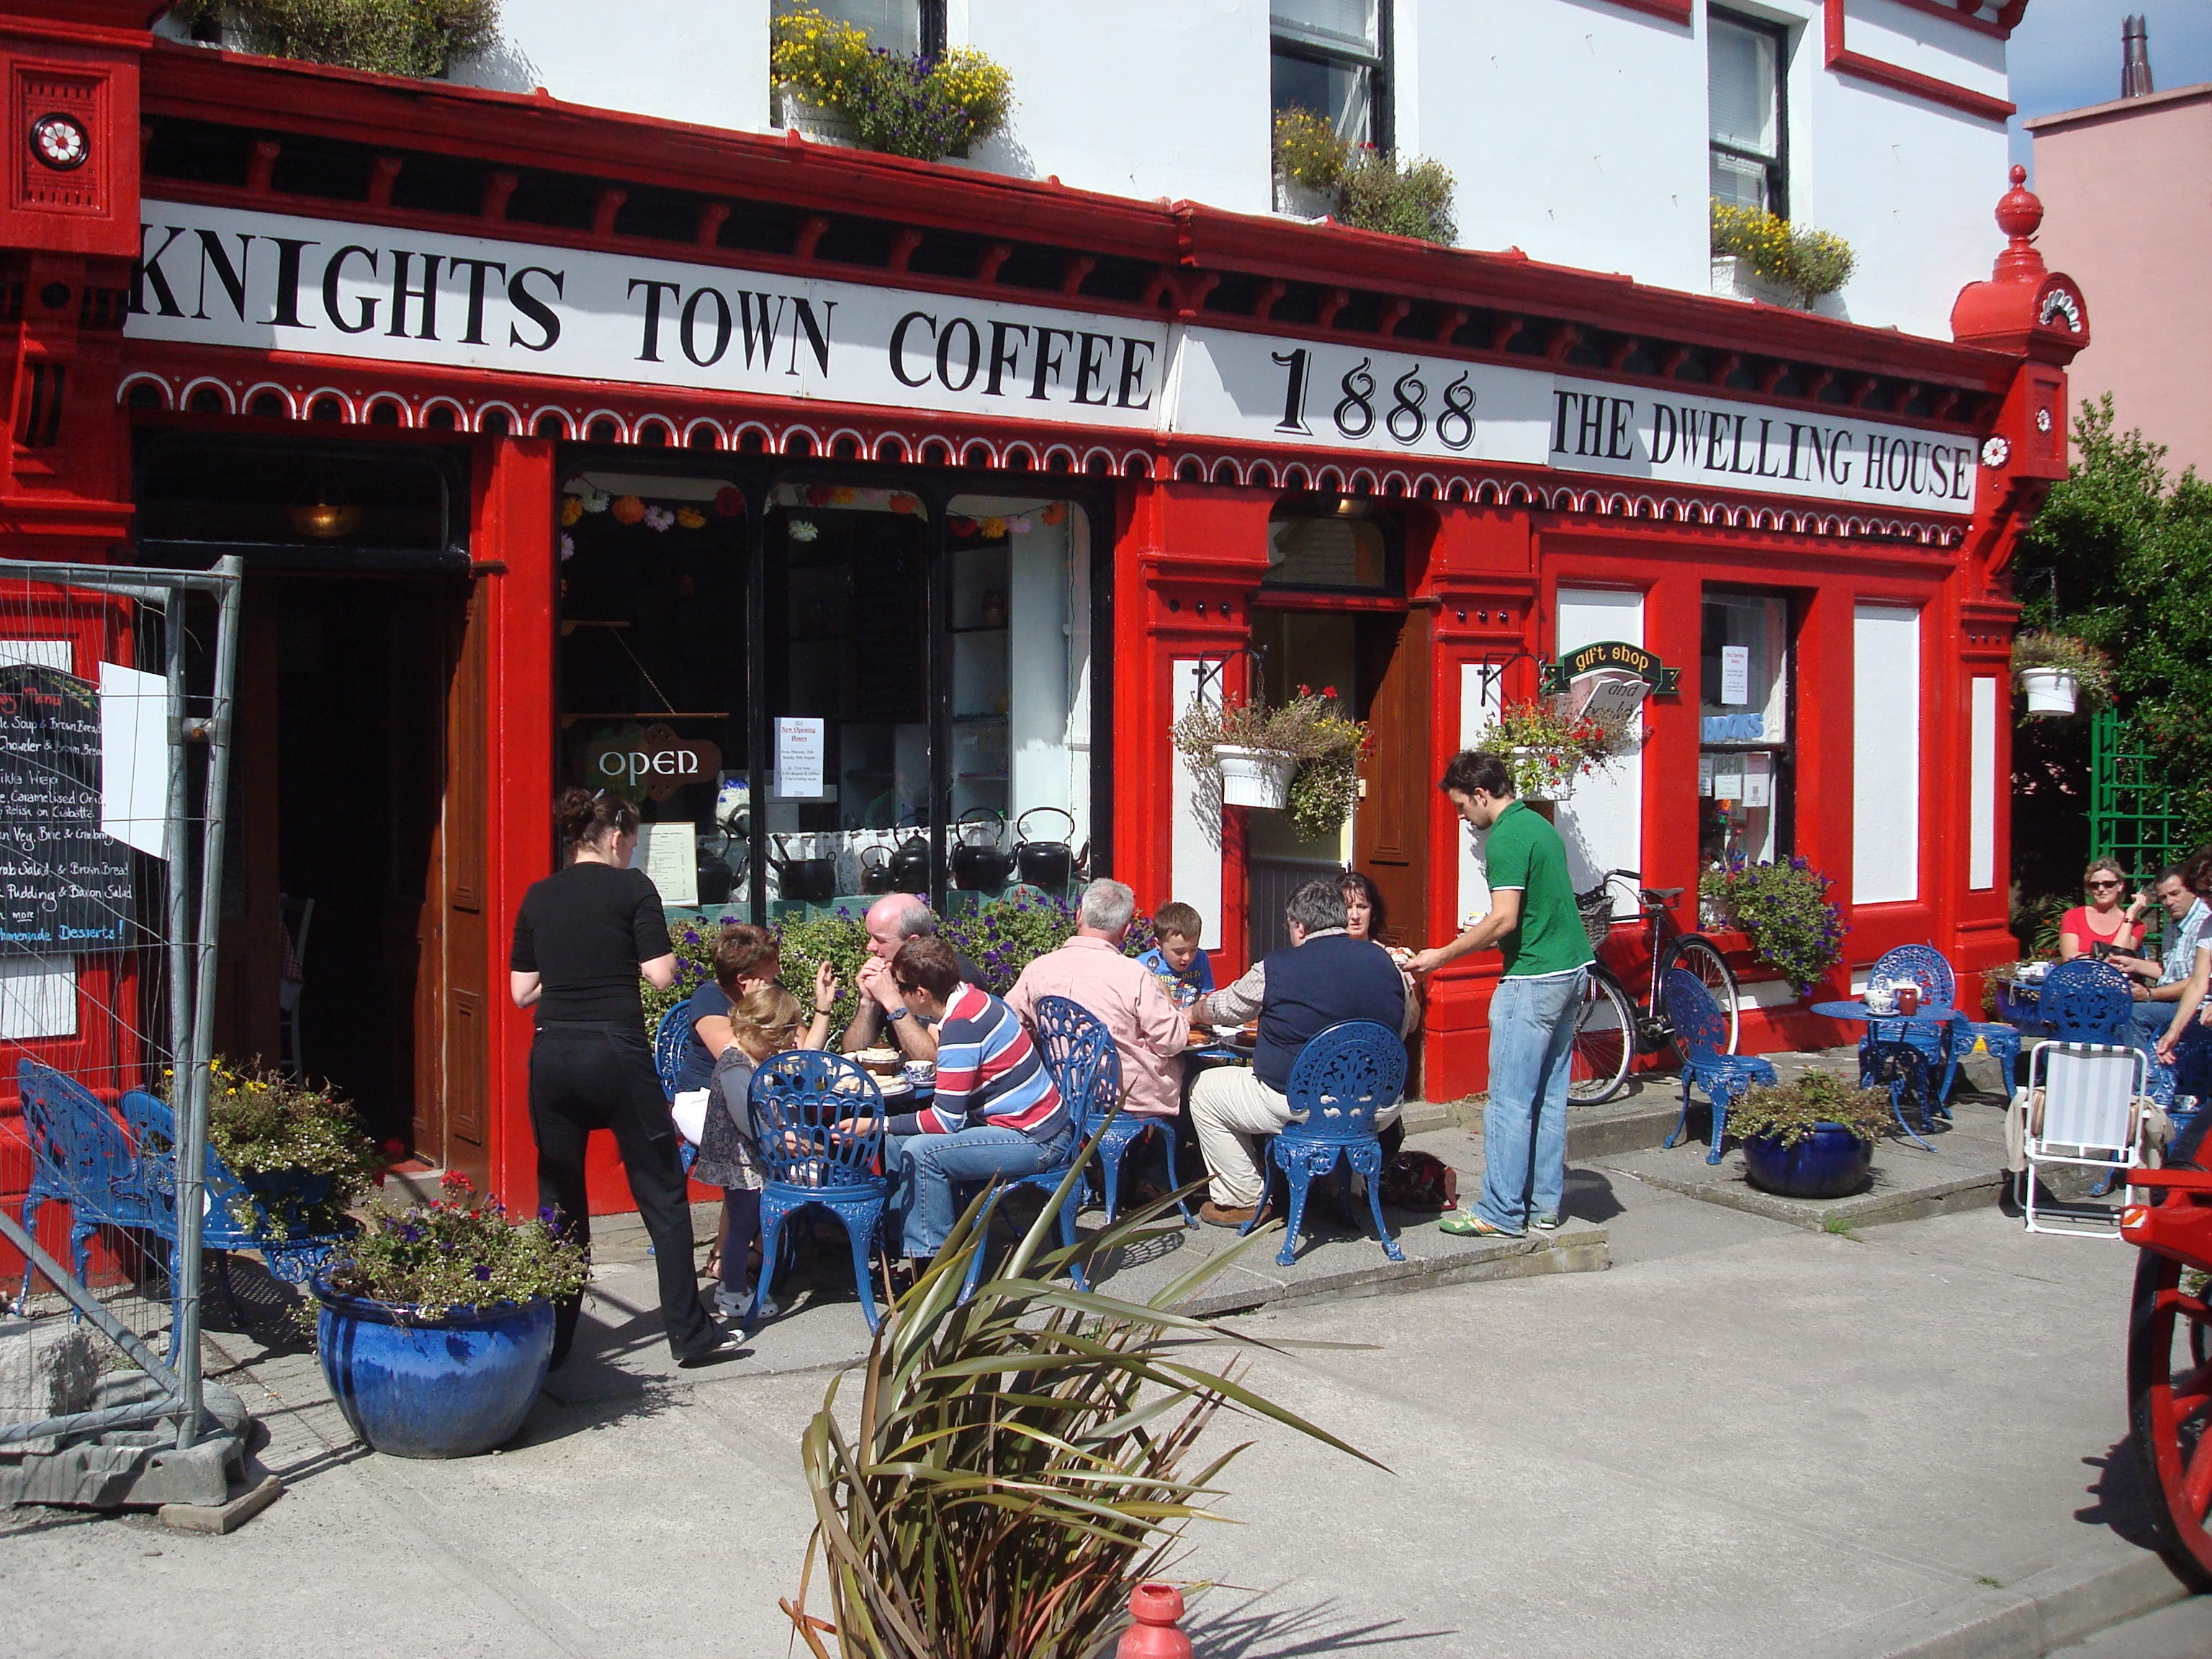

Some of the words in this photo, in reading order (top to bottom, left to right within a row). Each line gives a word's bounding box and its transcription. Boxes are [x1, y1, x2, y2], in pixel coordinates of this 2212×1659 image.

[128, 223, 565, 351] KNIGHTS
[627, 278, 837, 378] TOWN
[889, 311, 1155, 410] COFFEE
[1271, 348, 1477, 451] 1888
[1550, 390, 1635, 460] THE
[1647, 403, 1853, 486] DWELLING
[1863, 433, 1972, 501] HOUSE
[1575, 645, 1606, 672] gift
[1611, 644, 1649, 673] shop
[1608, 684, 1640, 697] and
[12, 716, 37, 734] Soup
[81, 743, 102, 755] Brea
[7, 884, 58, 912] Pudding
